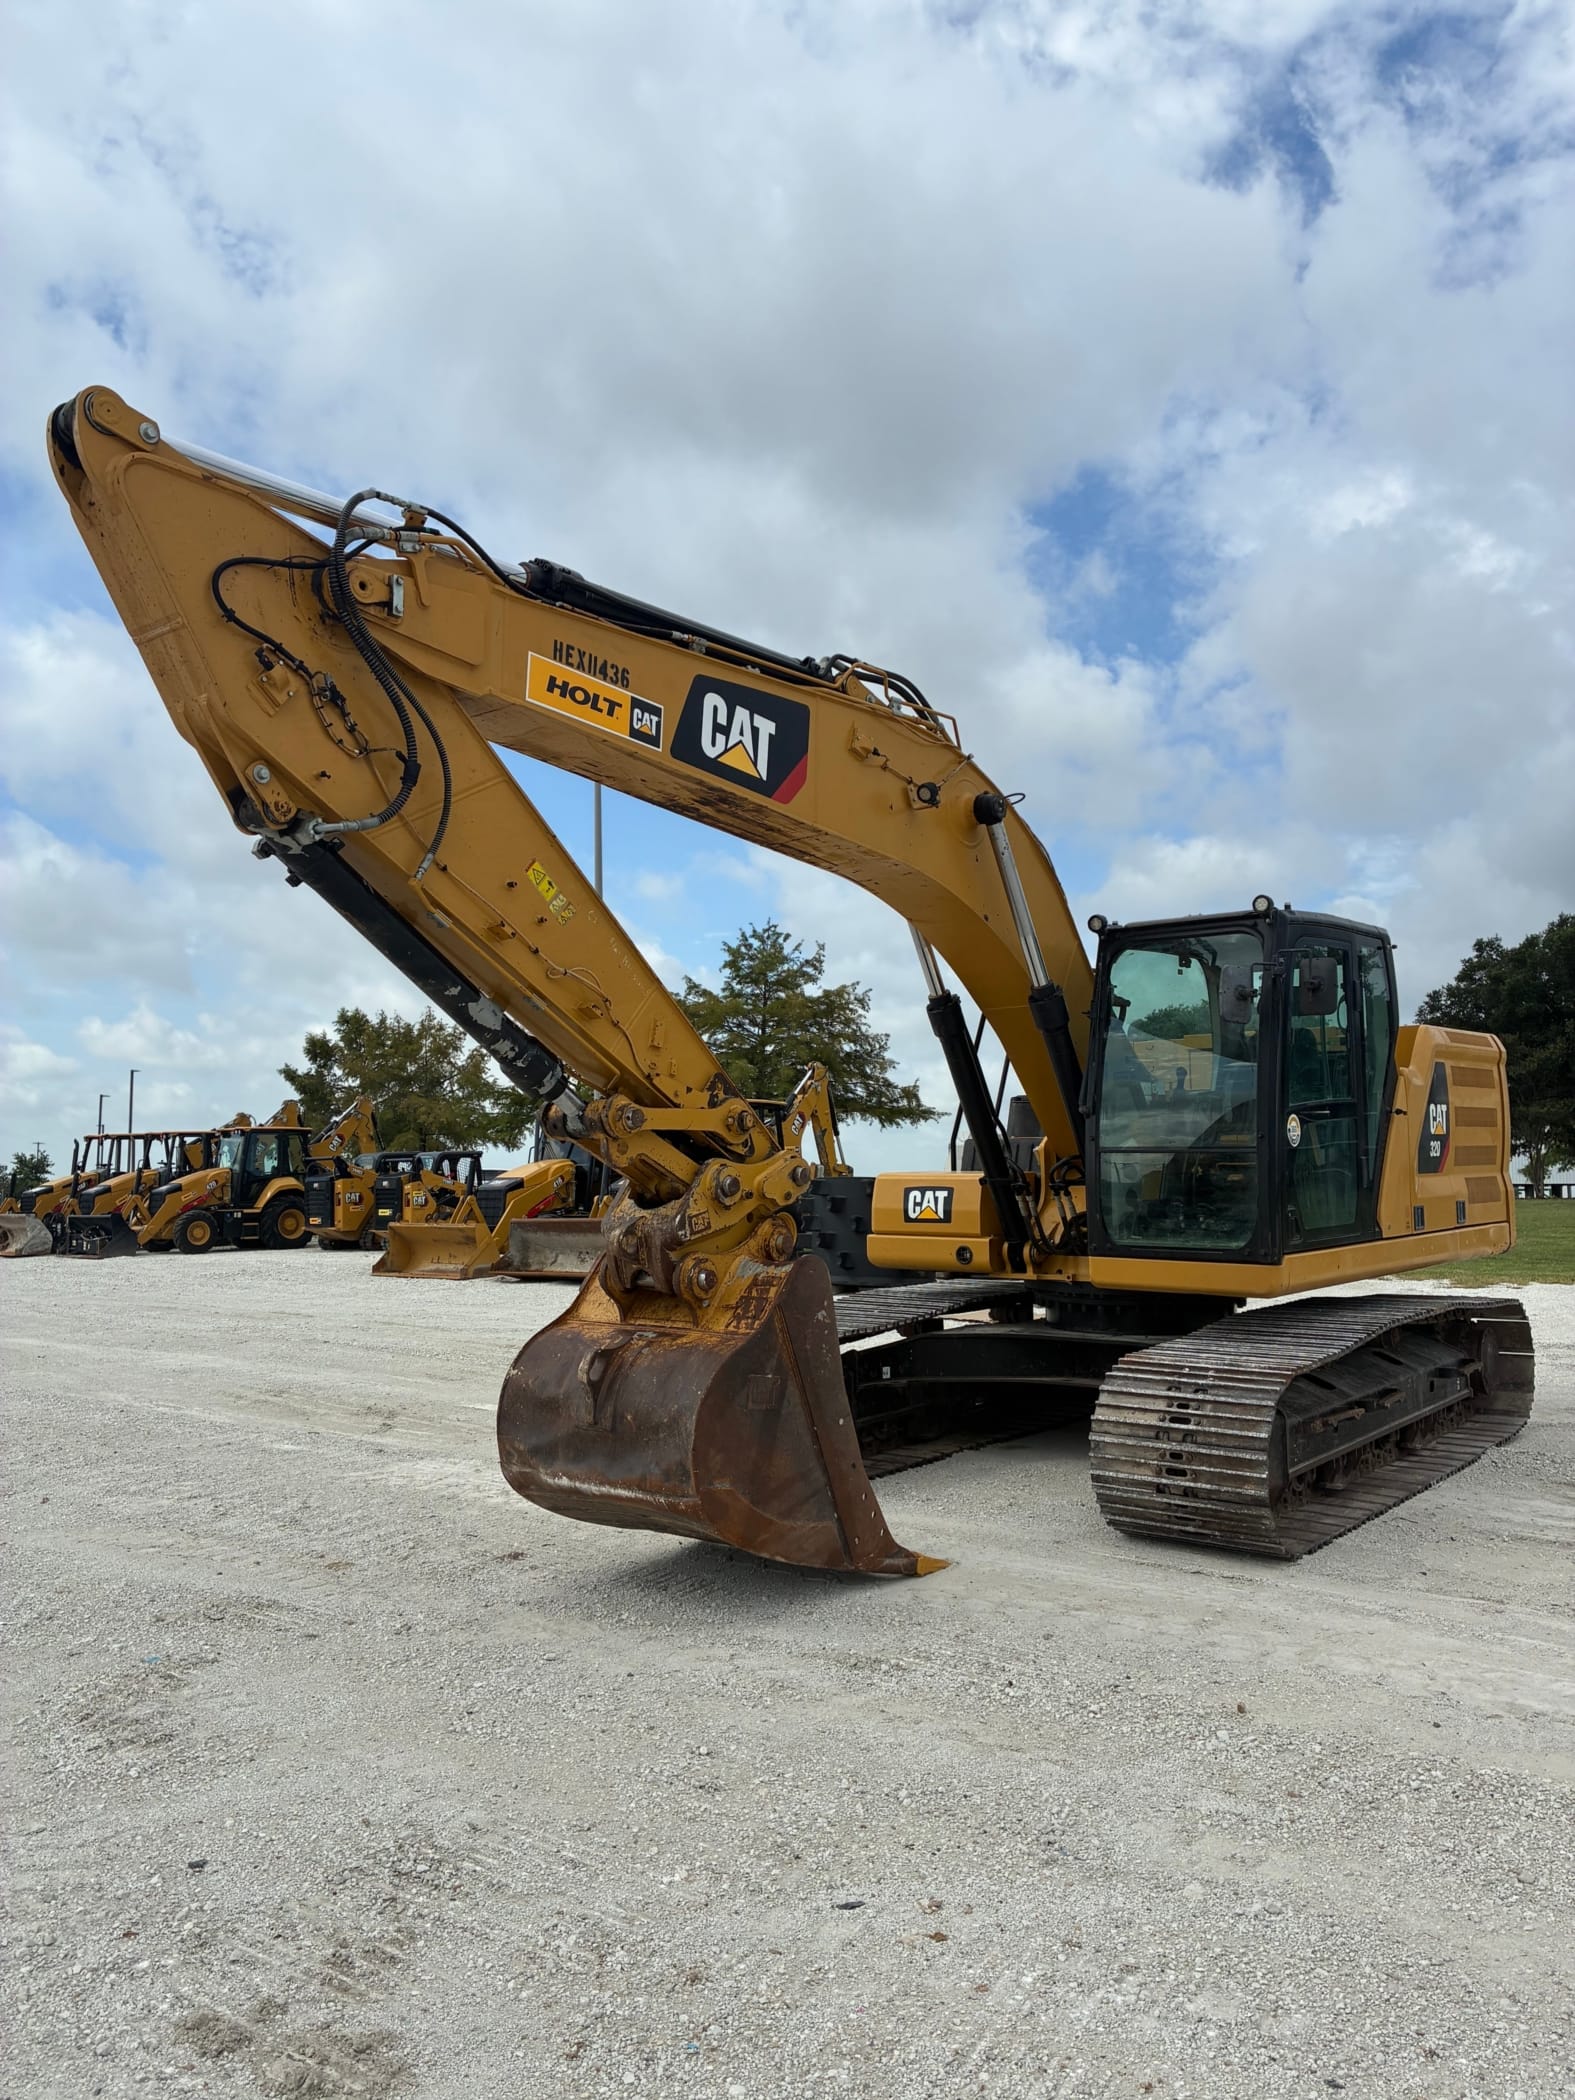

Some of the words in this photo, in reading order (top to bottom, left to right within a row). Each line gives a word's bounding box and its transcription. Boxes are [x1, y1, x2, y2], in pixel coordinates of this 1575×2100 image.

[553, 639, 630, 689] HEX11436
[546, 674, 623, 718] HOLT
[632, 707, 660, 737] CAT
[700, 692, 776, 782] CAT
[791, 1113, 803, 1136] CAT
[1429, 1103, 1447, 1135] CAT
[328, 1135, 342, 1152] CAT
[1429, 1140, 1441, 1157] 320
[345, 1192, 360, 1203] CAT
[413, 1196, 426, 1206] CAT
[908, 1190, 948, 1220] CAT
